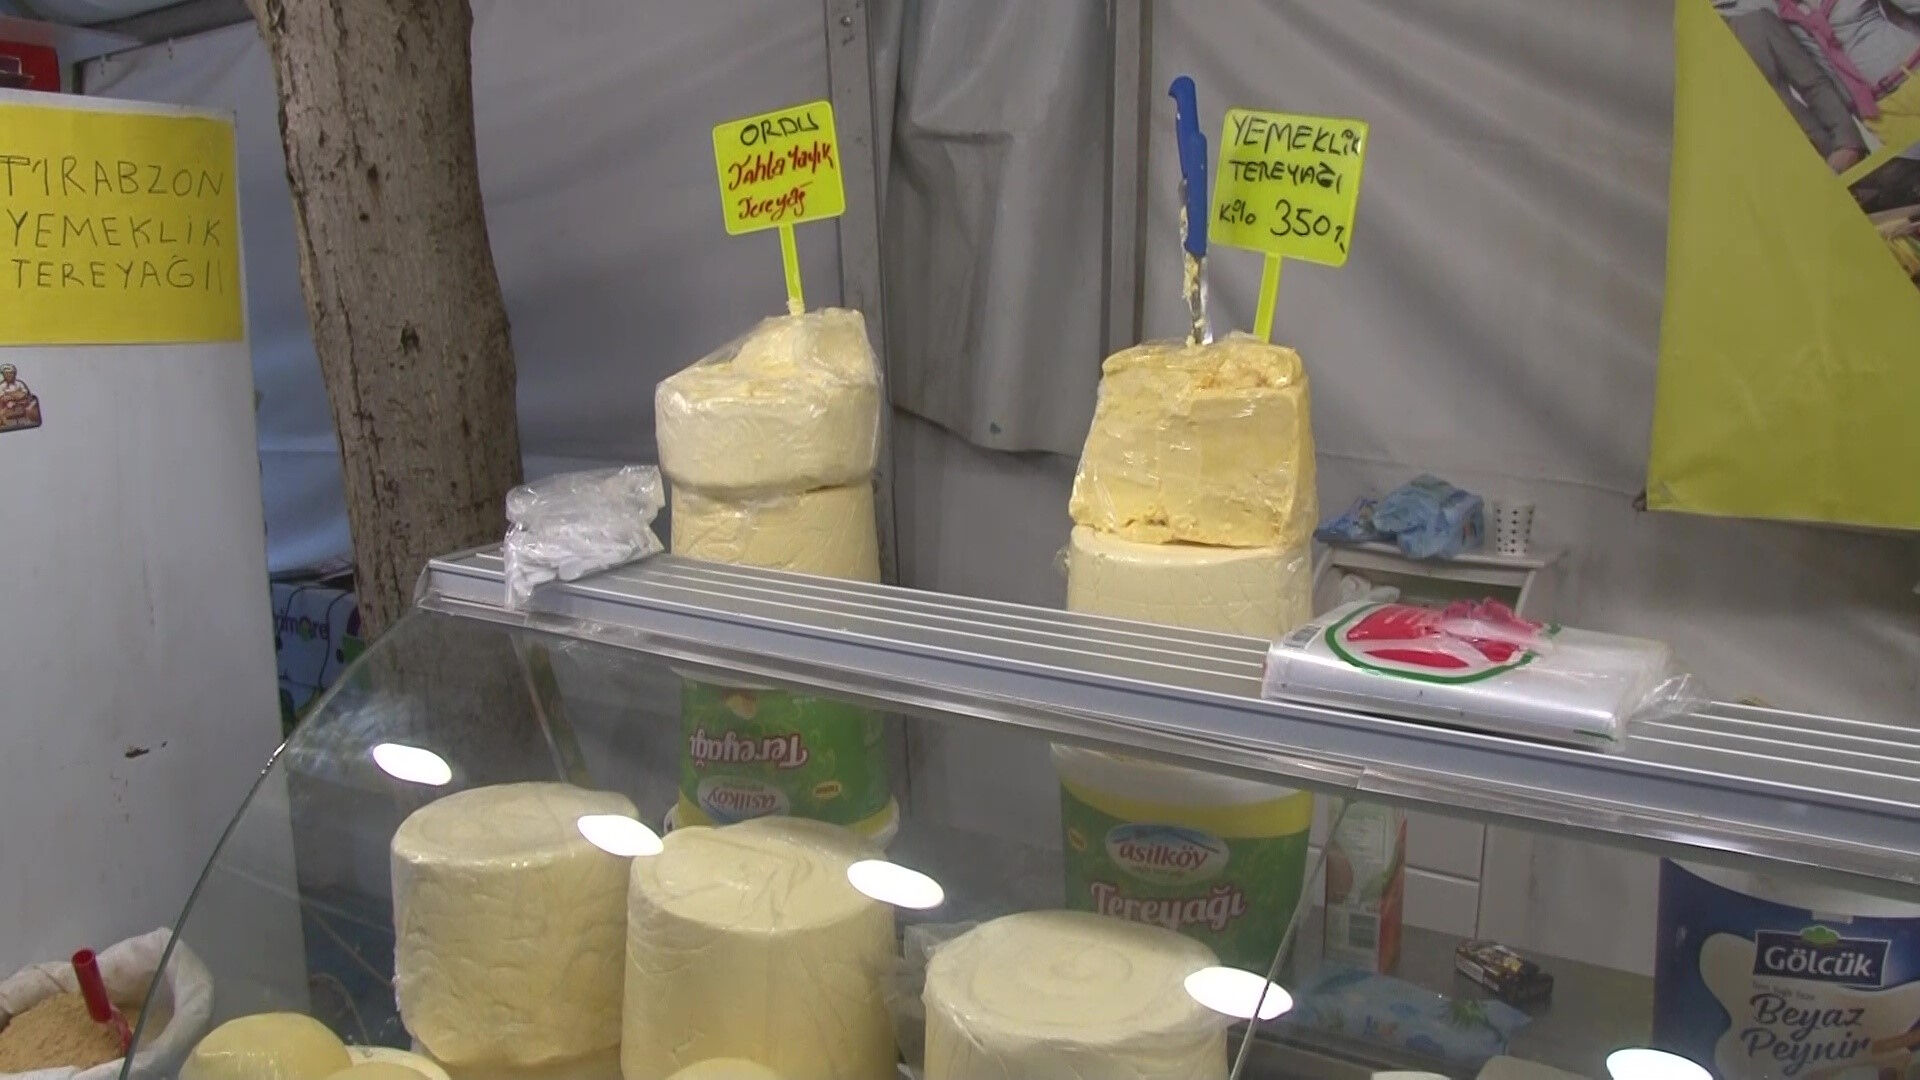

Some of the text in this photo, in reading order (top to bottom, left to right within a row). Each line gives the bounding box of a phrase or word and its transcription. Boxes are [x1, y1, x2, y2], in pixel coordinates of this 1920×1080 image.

[740, 112, 820, 146] ORDU
[1764, 945, 1873, 977] Gölcük
[1749, 992, 1866, 1041] Beyaz
[1740, 1026, 1872, 1077] Peynir
